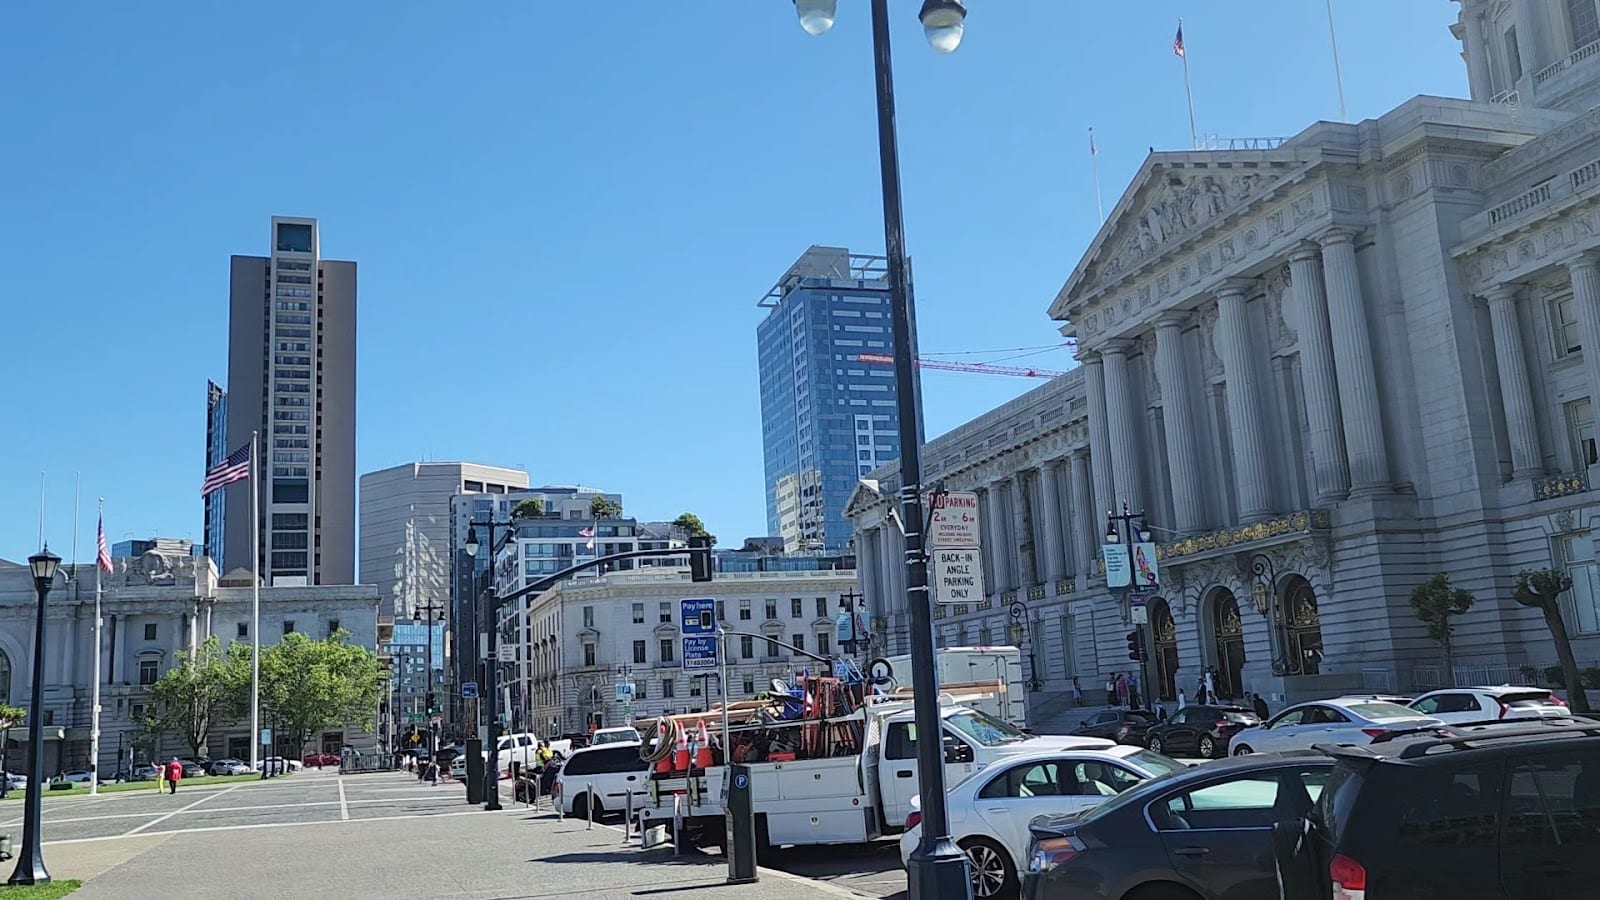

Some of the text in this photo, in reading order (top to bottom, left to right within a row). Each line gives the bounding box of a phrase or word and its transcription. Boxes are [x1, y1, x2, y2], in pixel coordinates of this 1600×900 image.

[945, 497, 976, 508] PARKING
[941, 553, 973, 563] BACK-IN
[947, 565, 970, 575] ANGLE
[943, 576, 974, 587] PARKING
[950, 588, 969, 598] ONLY
[682, 601, 713, 611] Pay here
[684, 637, 706, 646] Pay by
[684, 643, 709, 652] License
[738, 776, 745, 786] P
